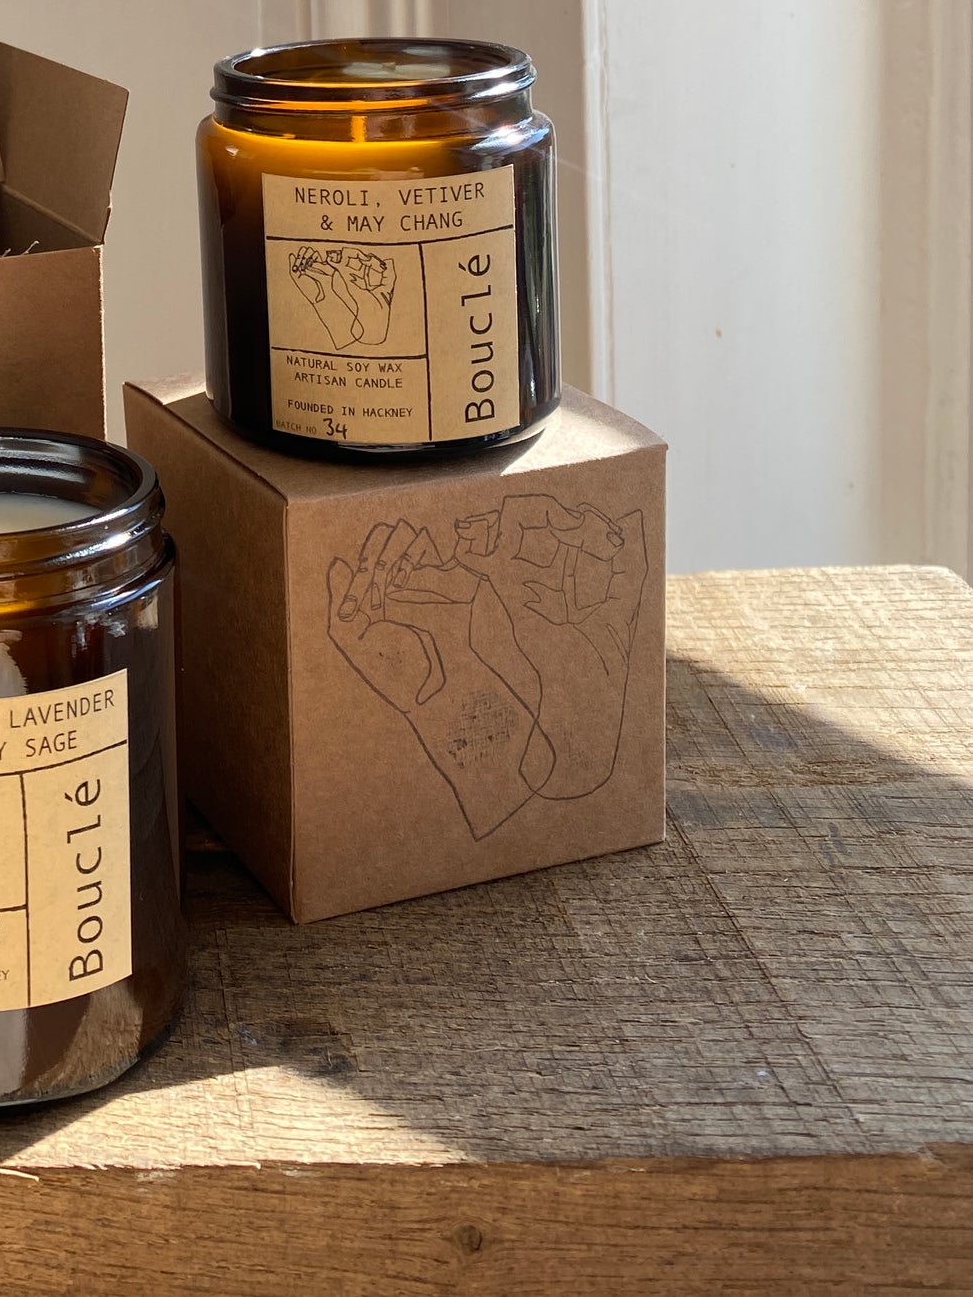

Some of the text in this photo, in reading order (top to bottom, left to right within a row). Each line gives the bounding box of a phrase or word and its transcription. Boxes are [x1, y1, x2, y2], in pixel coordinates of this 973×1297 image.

[295, 182, 485, 208] NEROLI, VETIVER
[320, 211, 463, 232] & MAY CHANG
[458, 254, 495, 423] Bouclé
[286, 355, 403, 373] NATURAL SOY WAX
[294, 372, 403, 389] ARTISAN CANDLE
[287, 399, 413, 418] FOUNDED IN HACKNEY
[275, 417, 348, 440] BATCH NO 34
[9, 688, 114, 729] LAVENDER
[25, 730, 78, 758] SAGE
[64, 779, 104, 981] Bouclé
